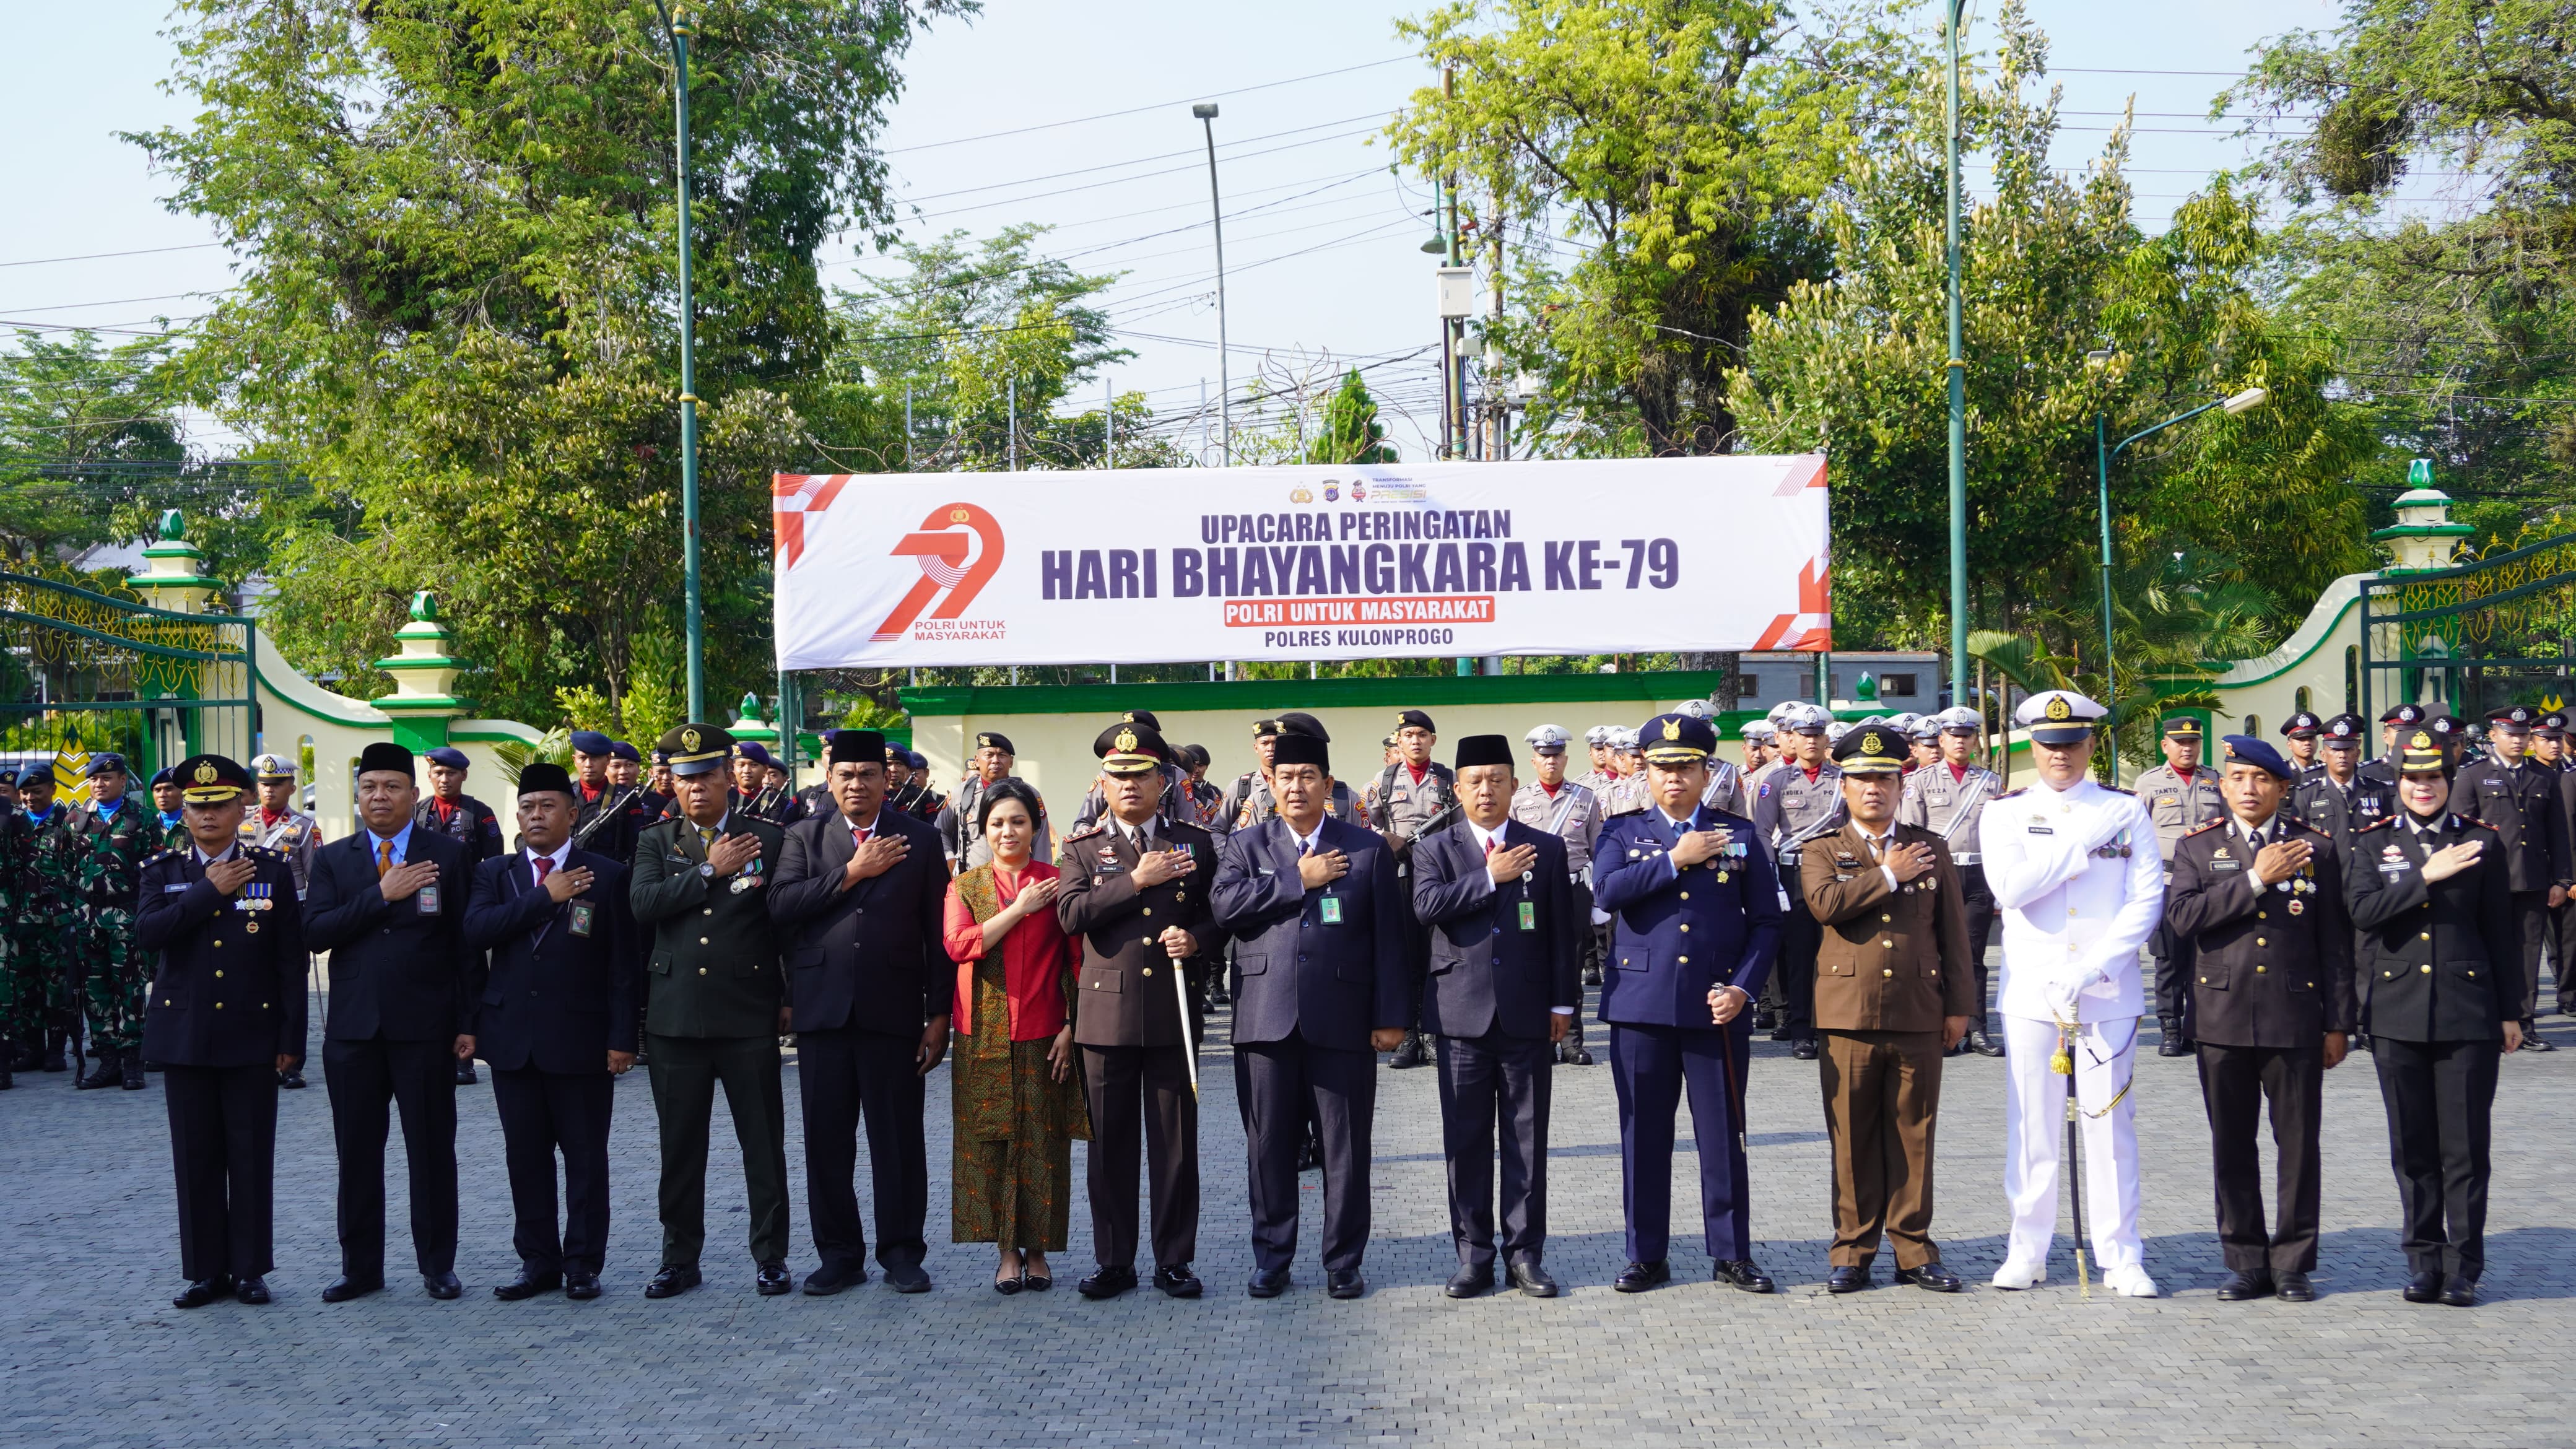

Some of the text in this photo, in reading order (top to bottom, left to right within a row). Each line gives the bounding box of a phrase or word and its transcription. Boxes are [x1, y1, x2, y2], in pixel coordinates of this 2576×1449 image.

[1370, 490, 1427, 499] PRESISI
[1201, 510, 1511, 544] UPACARA PERINGATAN
[1042, 537, 1679, 601] HARI BHAYANGKARA KE-79
[1225, 600, 1490, 624] POLRI UNTUK MASYARAKAT
[915, 620, 1005, 630] POLRI UNTUK
[915, 630, 1006, 640] MASYARAKAT
[1265, 627, 1453, 648] POLRES KULONPROGO
[2154, 787, 2178, 795] TANTO
[1518, 804, 1541, 812] THANOV
